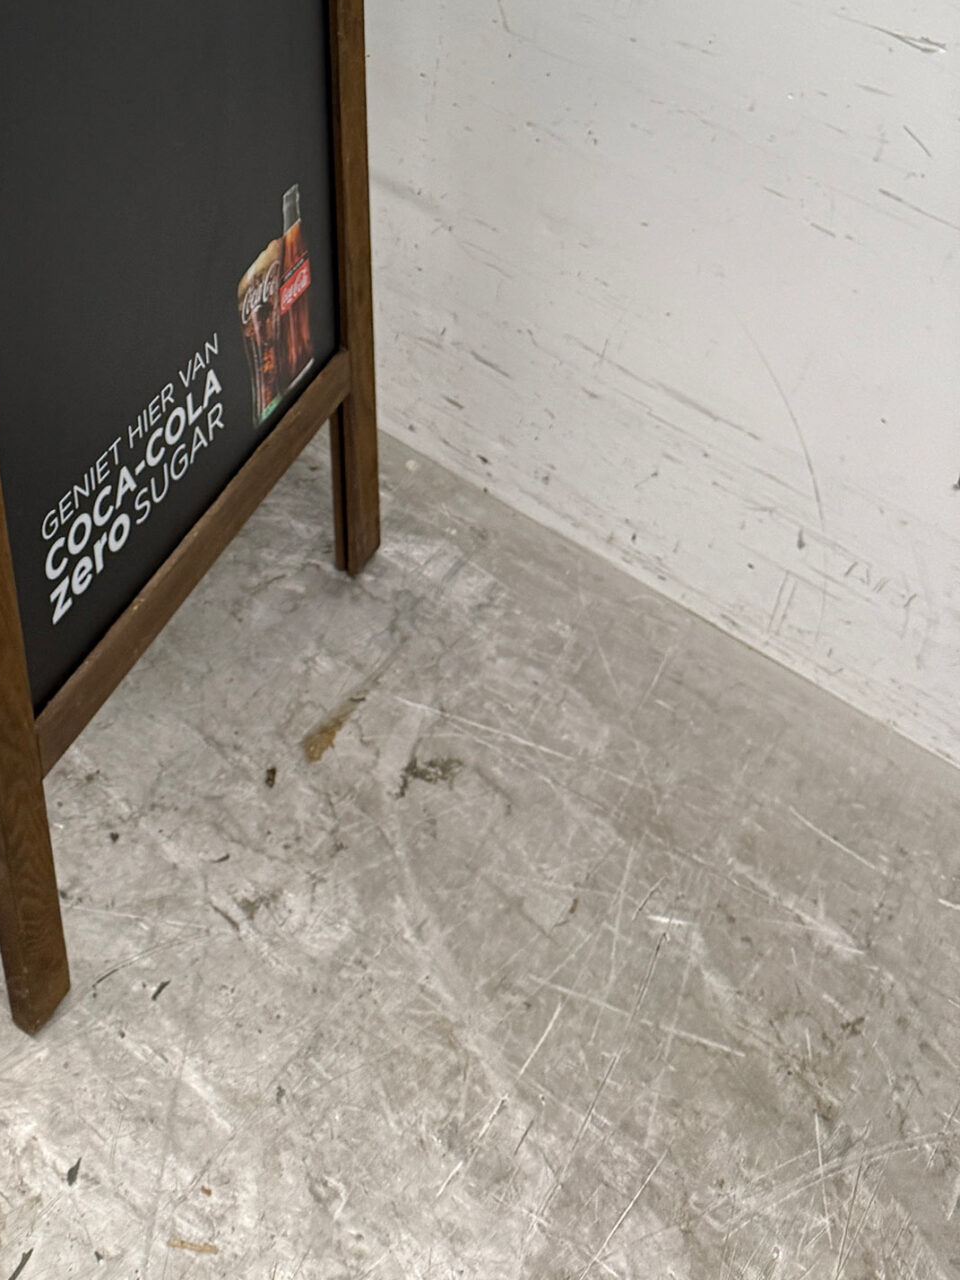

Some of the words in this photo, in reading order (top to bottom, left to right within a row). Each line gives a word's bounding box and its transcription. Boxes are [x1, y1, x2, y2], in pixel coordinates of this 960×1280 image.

[41, 436, 120, 540] GENIET
[127, 382, 175, 451] HIER
[178, 332, 220, 388] VAN
[44, 367, 223, 582] COCA-COLA
[49, 512, 131, 625] zero
[135, 402, 226, 525] SUGAR
